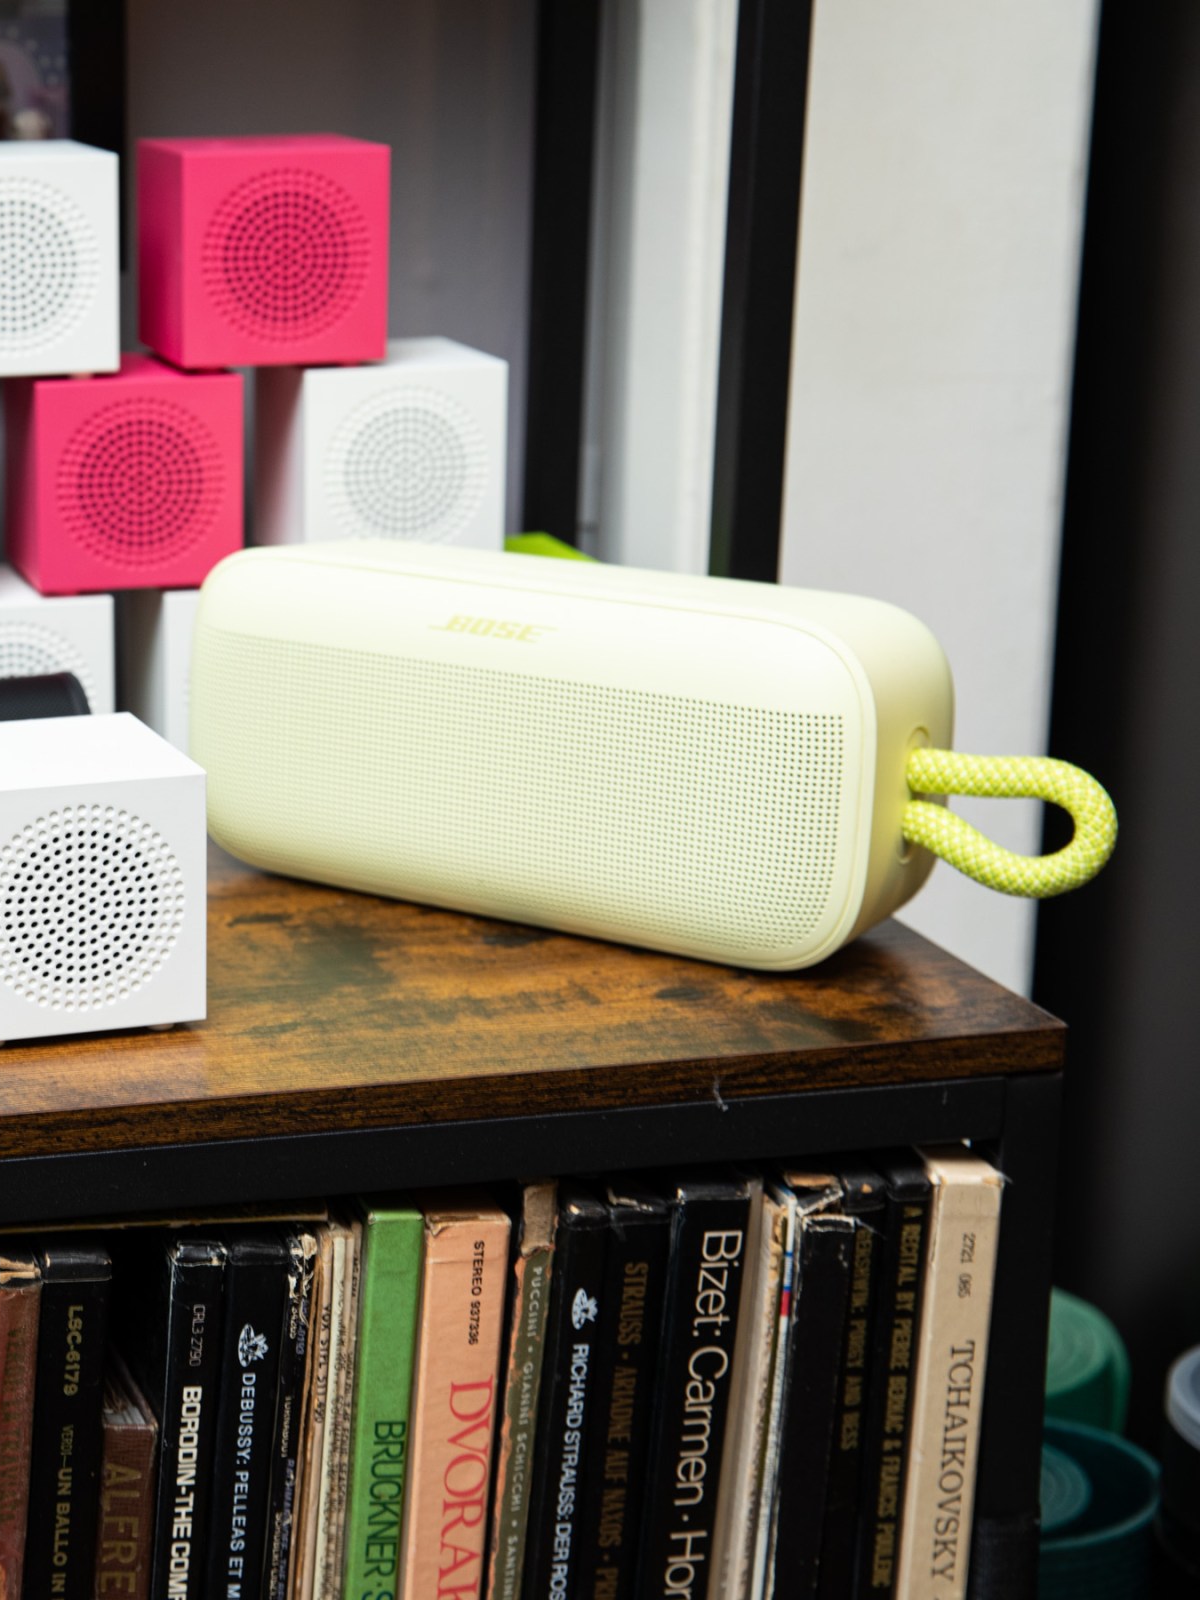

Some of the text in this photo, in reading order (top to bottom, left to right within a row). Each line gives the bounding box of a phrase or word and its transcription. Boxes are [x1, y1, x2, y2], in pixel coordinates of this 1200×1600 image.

[429, 612, 557, 644] BOSE
[471, 1240, 485, 1297] STEREO
[693, 1230, 744, 1337] Bizet:
[960, 1232, 977, 1265] 2721
[527, 1265, 543, 1338] PUCCINI
[617, 1262, 649, 1345] STRAUSS
[63, 1304, 84, 1397] LSC-6179
[566, 1343, 590, 1429] RICHARD
[236, 1371, 256, 1465] DEBUSSY:
[519, 1361, 534, 1425] GIANNI
[608, 1365, 639, 1444] ARIADNE
[673, 1346, 729, 1507] Carmen
[173, 1385, 203, 1539] BORODIN-THE
[363, 1420, 406, 1578] BRUCKNER
[511, 1432, 528, 1513] SCHICCHI
[556, 1430, 581, 1521] STRAUSS:
[604, 1449, 628, 1483] AUF
[931, 1340, 977, 1583] TCHAIKOVSKY
[54, 1502, 70, 1567] BALLO
[101, 1462, 142, 1594] ALFRE
[230, 1470, 250, 1552] PELLEAS
[553, 1522, 572, 1562] DER
[598, 1487, 626, 1549] NAXOS
[51, 1572, 66, 1593] IN
[227, 1556, 244, 1580] ET
